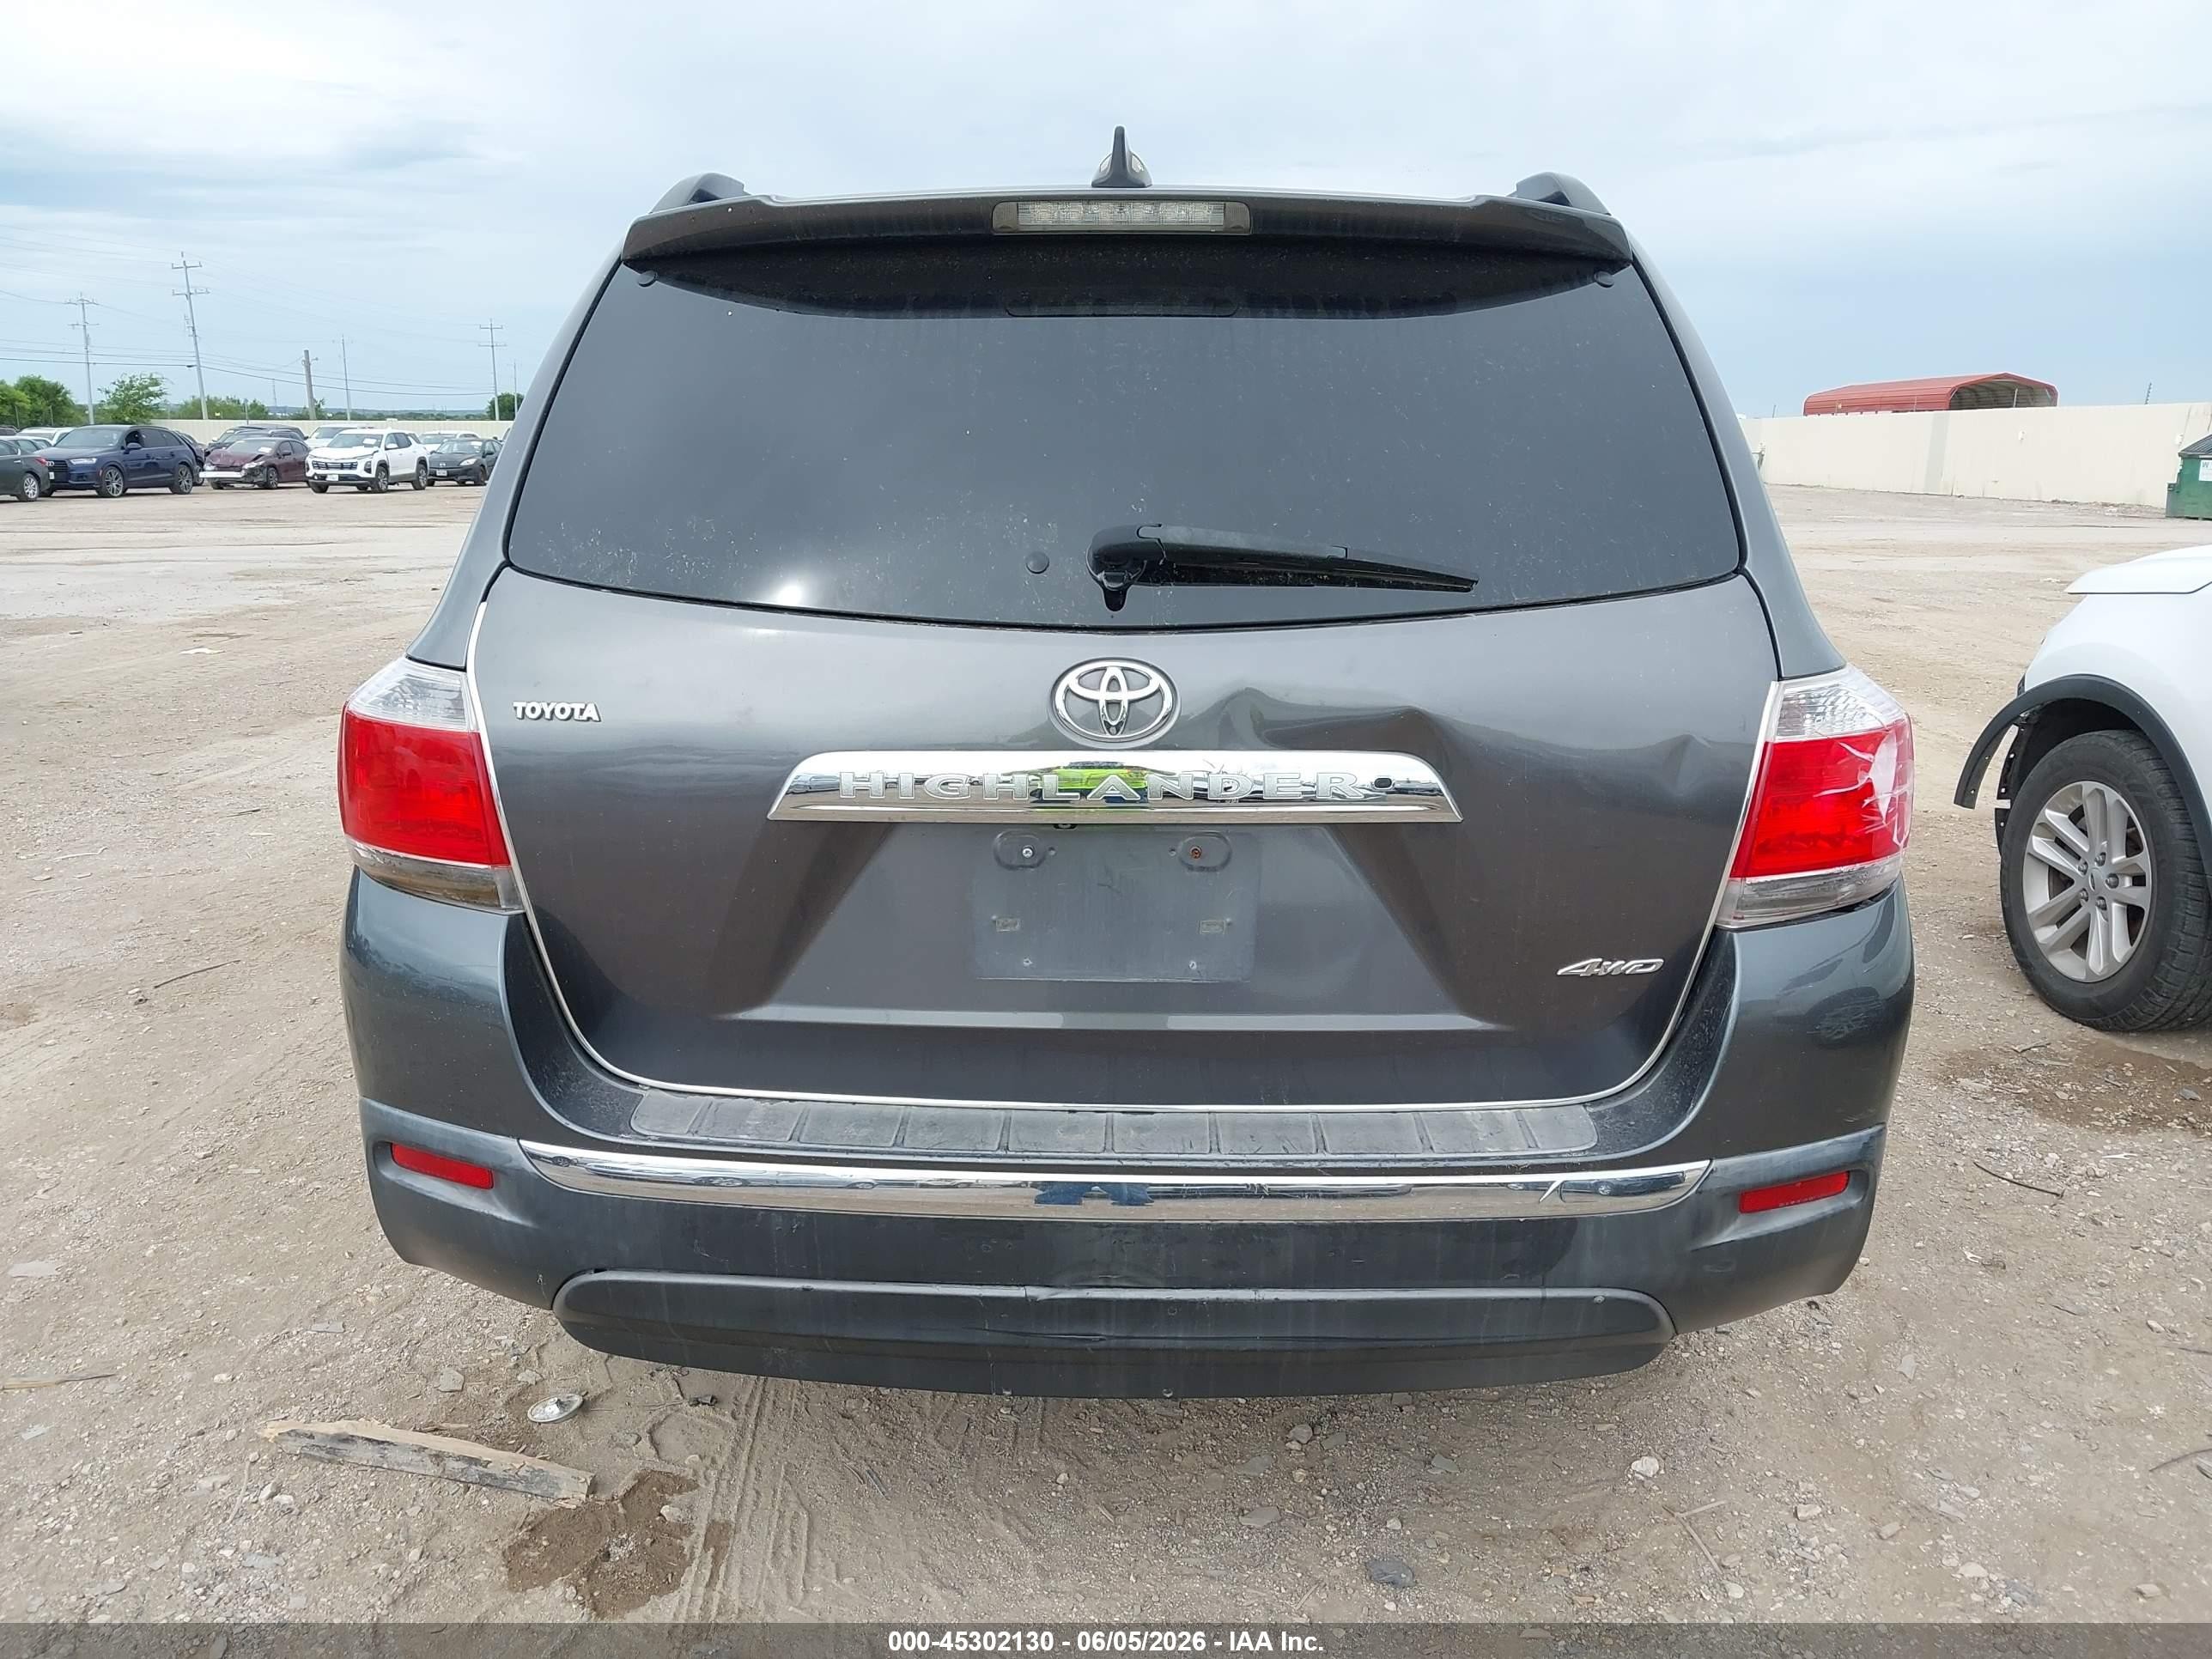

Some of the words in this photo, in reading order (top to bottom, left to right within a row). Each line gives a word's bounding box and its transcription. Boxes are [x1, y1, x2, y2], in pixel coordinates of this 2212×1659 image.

[514, 701, 602, 722] TOYOTA
[839, 771, 1364, 800] HIGHLANDER
[1557, 957, 1664, 976] 4WD
